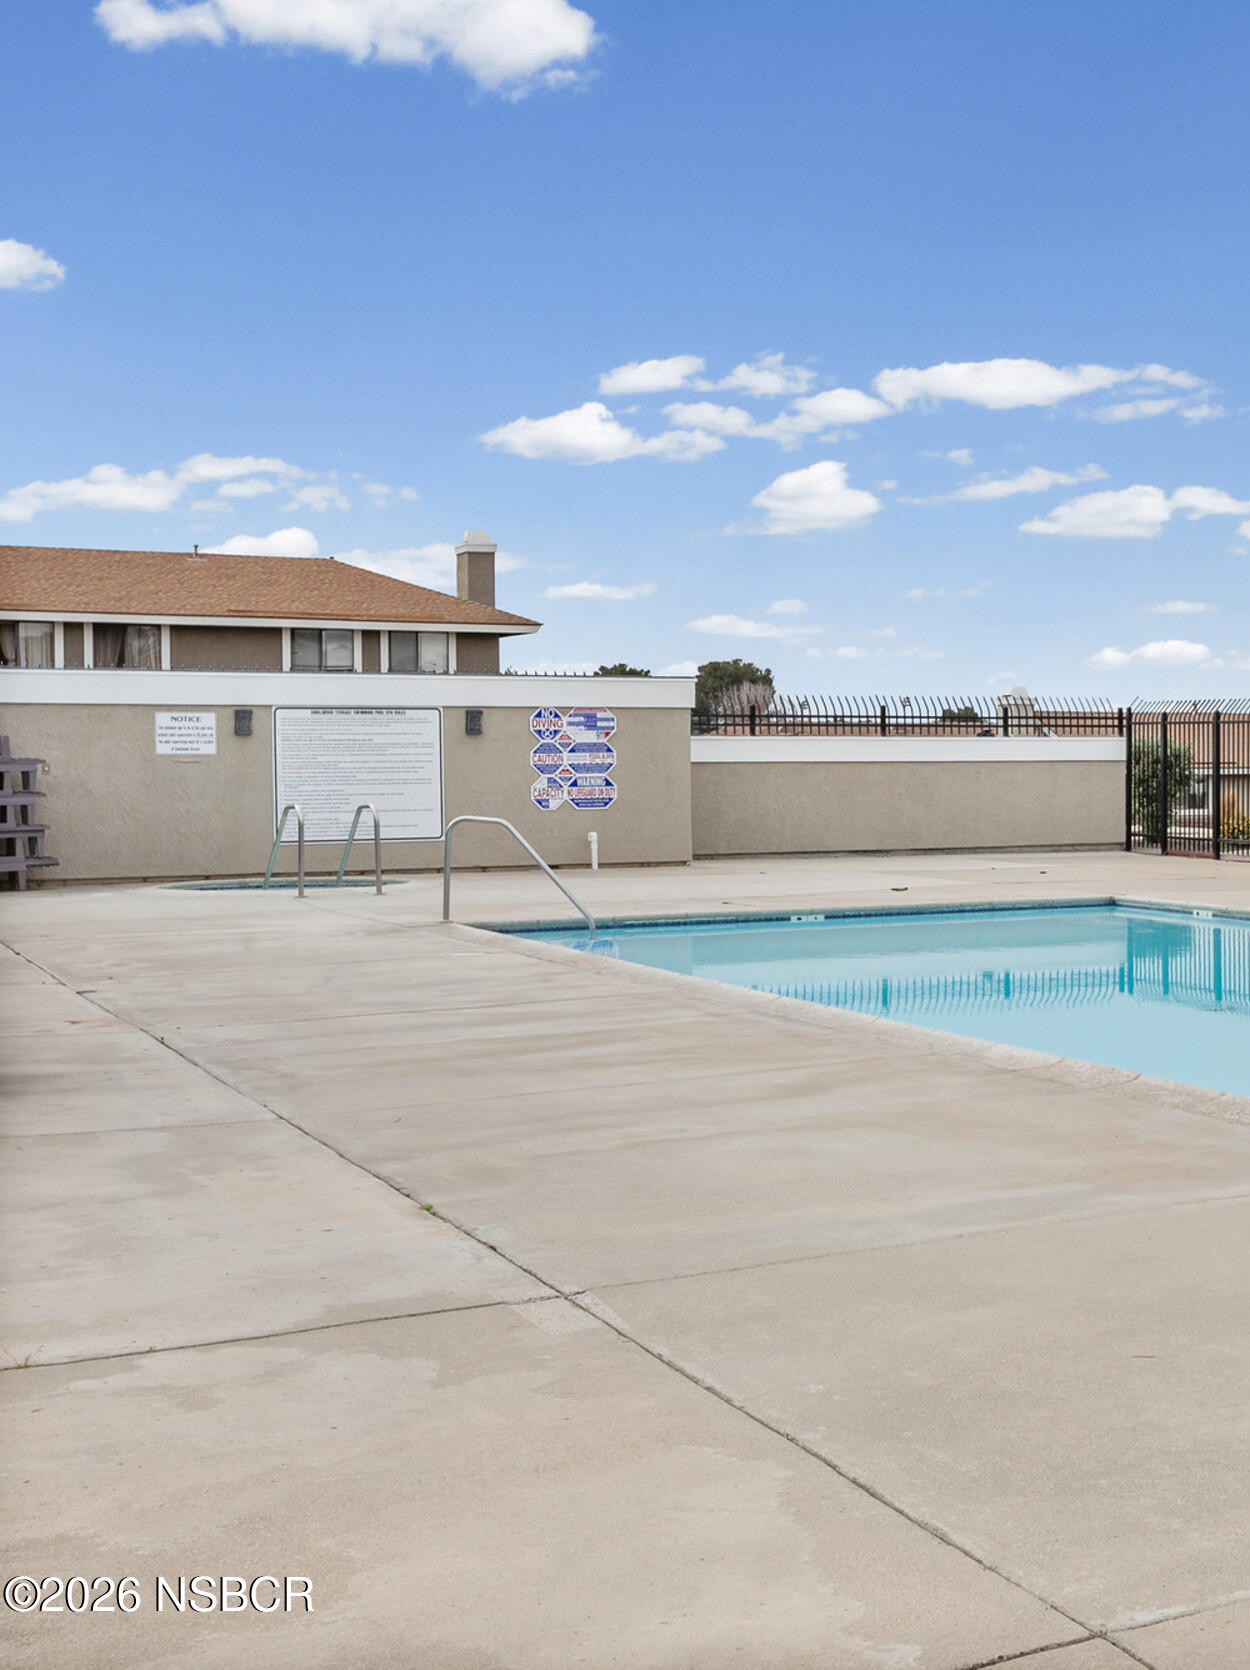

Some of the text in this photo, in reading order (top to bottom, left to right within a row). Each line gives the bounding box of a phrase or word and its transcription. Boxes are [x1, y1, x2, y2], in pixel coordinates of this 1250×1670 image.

[541, 706, 555, 718] NO
[170, 715, 201, 723] NOTICE
[531, 718, 564, 729] DIVING
[531, 754, 564, 763] CAUTION
[534, 787, 565, 798] CAPACITY
[567, 787, 616, 797] NO LIFEGUARD ON DUTY
